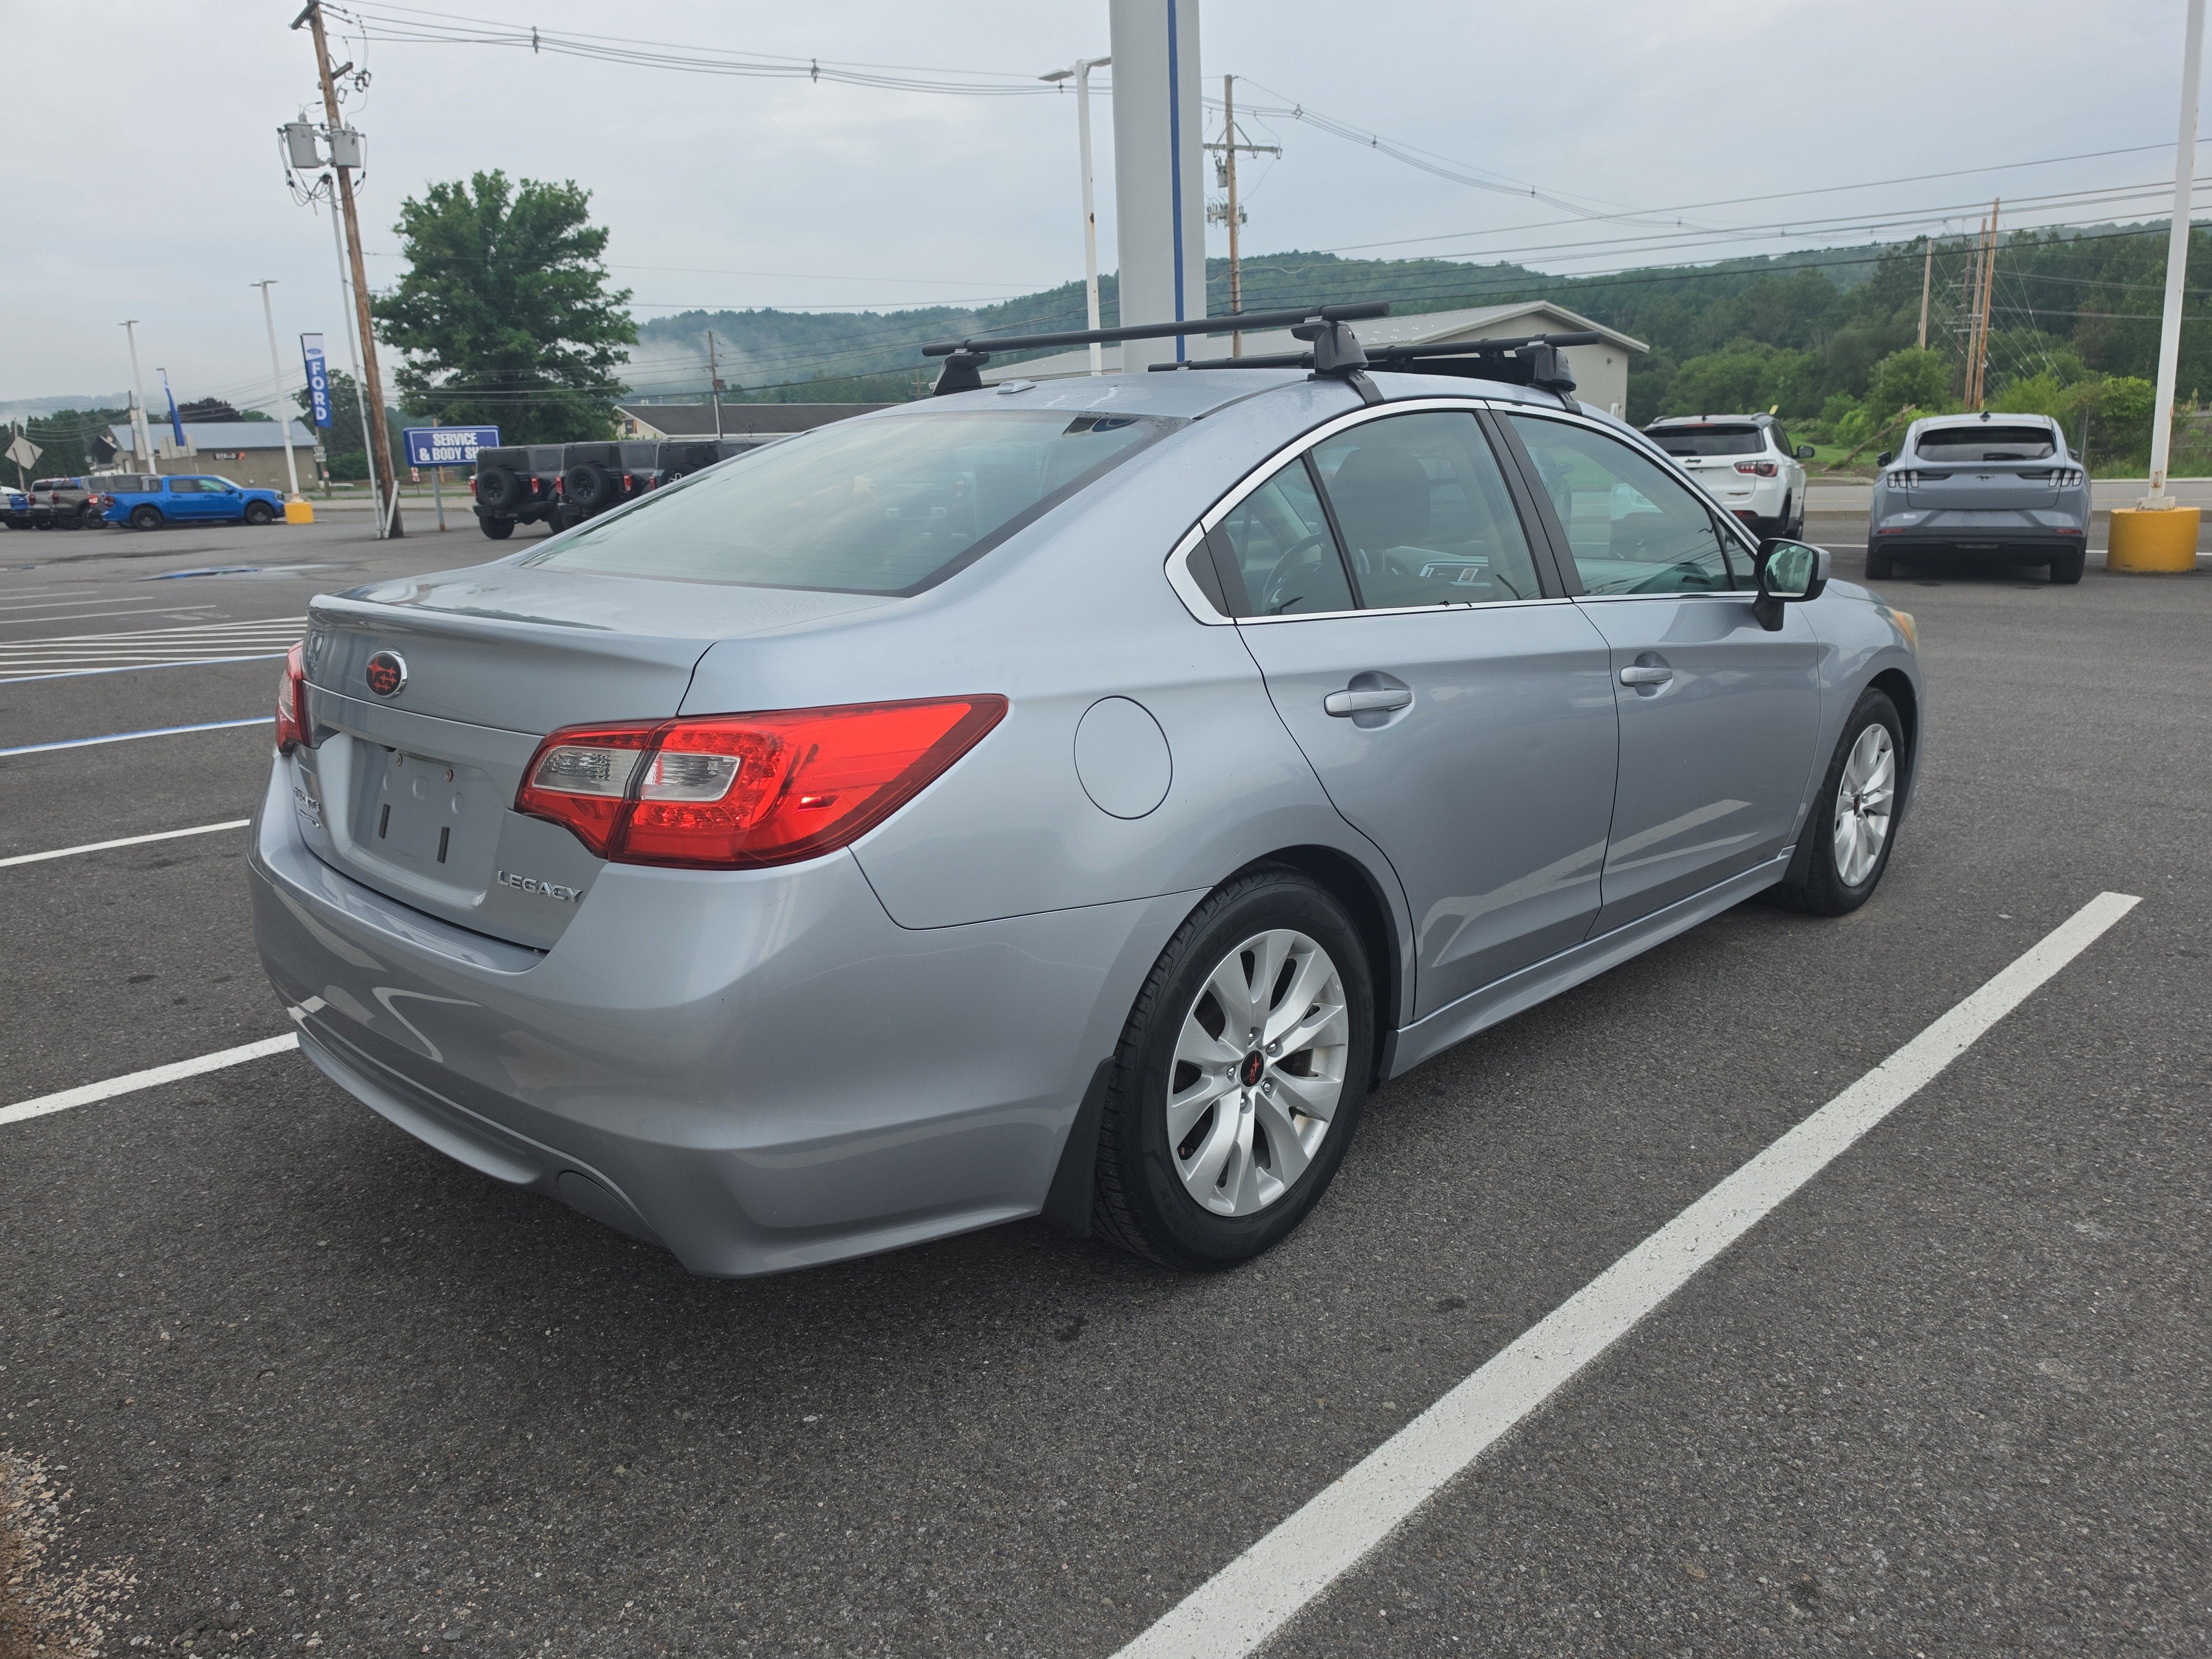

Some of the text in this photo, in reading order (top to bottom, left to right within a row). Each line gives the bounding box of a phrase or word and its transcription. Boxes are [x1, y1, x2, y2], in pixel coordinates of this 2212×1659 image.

[312, 361, 326, 420] FORD
[433, 433, 478, 446] SERVICE
[419, 447, 430, 461] &
[432, 447, 462, 460] BODY
[498, 870, 583, 902] LEGACY
